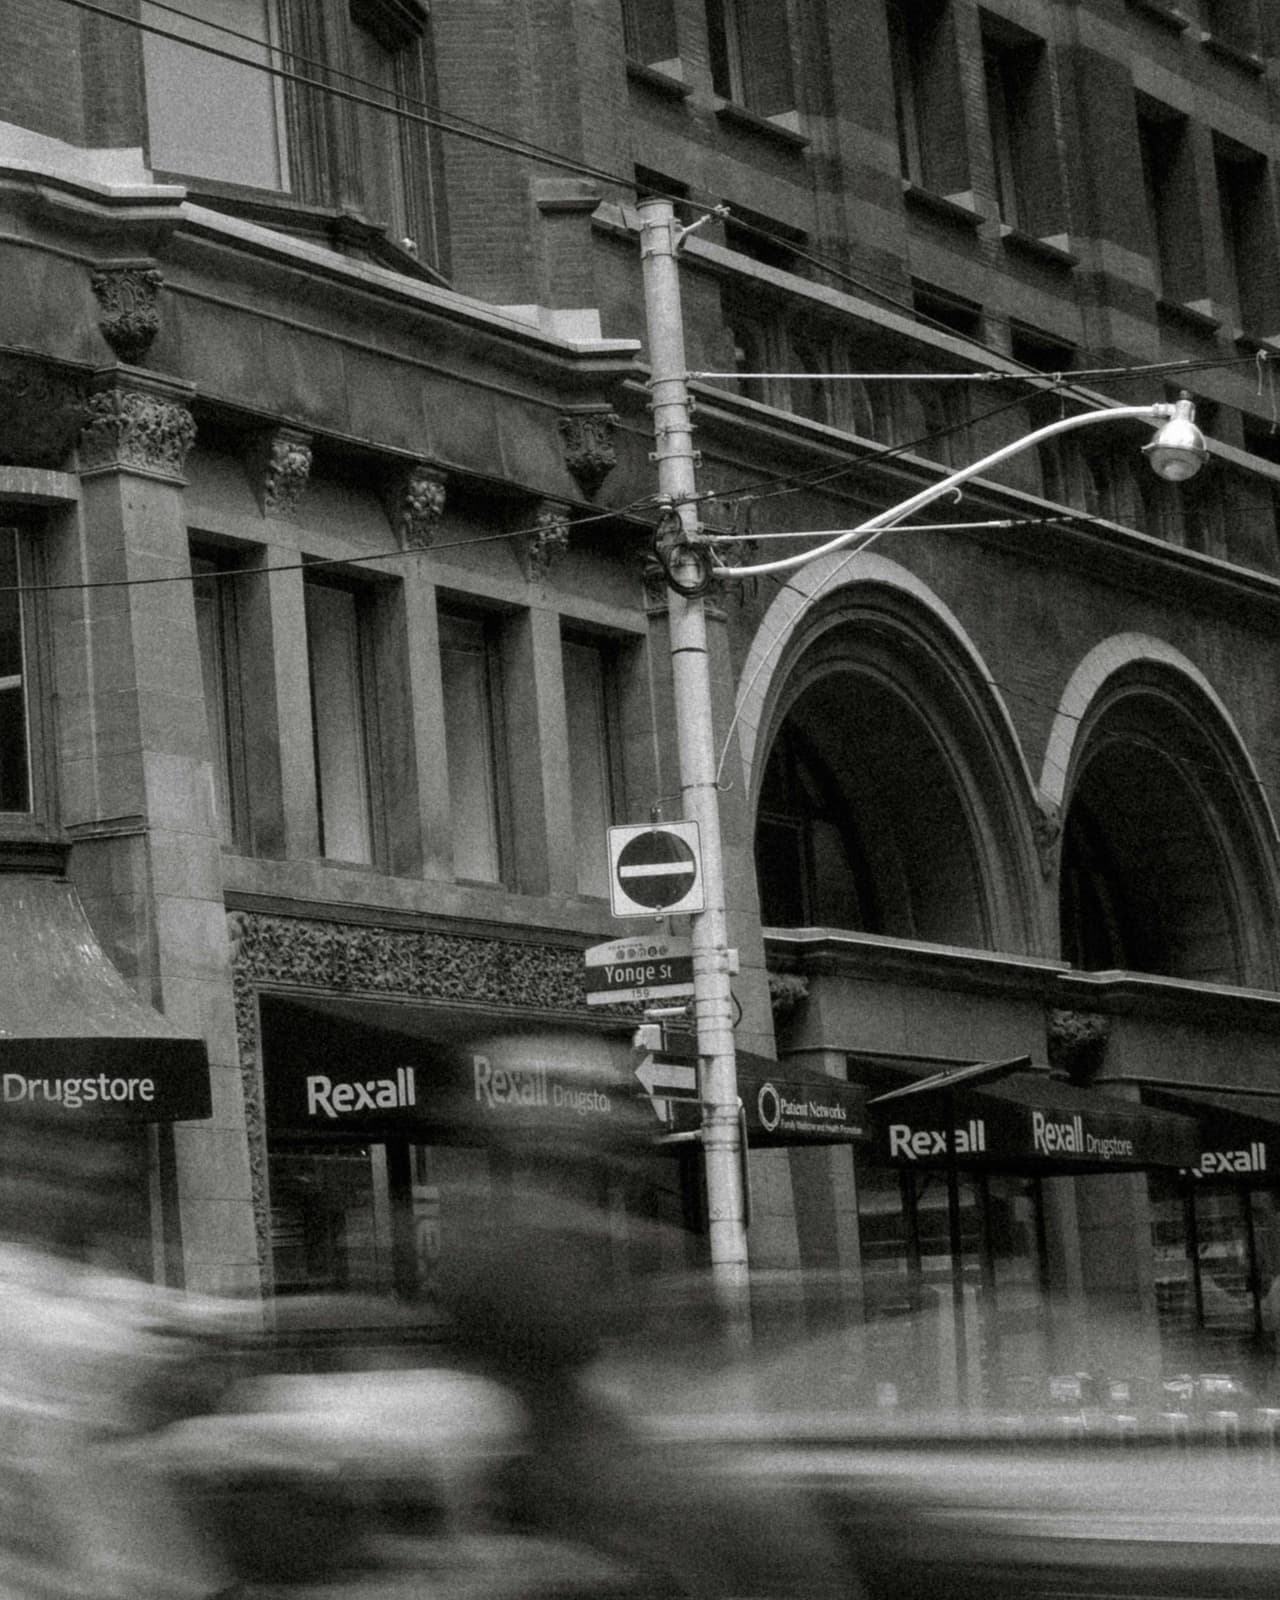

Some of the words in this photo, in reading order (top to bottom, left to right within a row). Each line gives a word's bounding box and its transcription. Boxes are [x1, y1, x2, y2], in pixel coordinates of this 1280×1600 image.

[605, 965, 655, 985] Yonge
[660, 964, 672, 979] St
[2, 1073, 155, 1108] Drugstore
[306, 1066, 416, 1118] Rexall
[889, 1119, 985, 1160] Rexall
[1032, 1111, 1084, 1156] Rexall
[1086, 1133, 1133, 1160] Drugstore
[1179, 1142, 1267, 1178] exall
